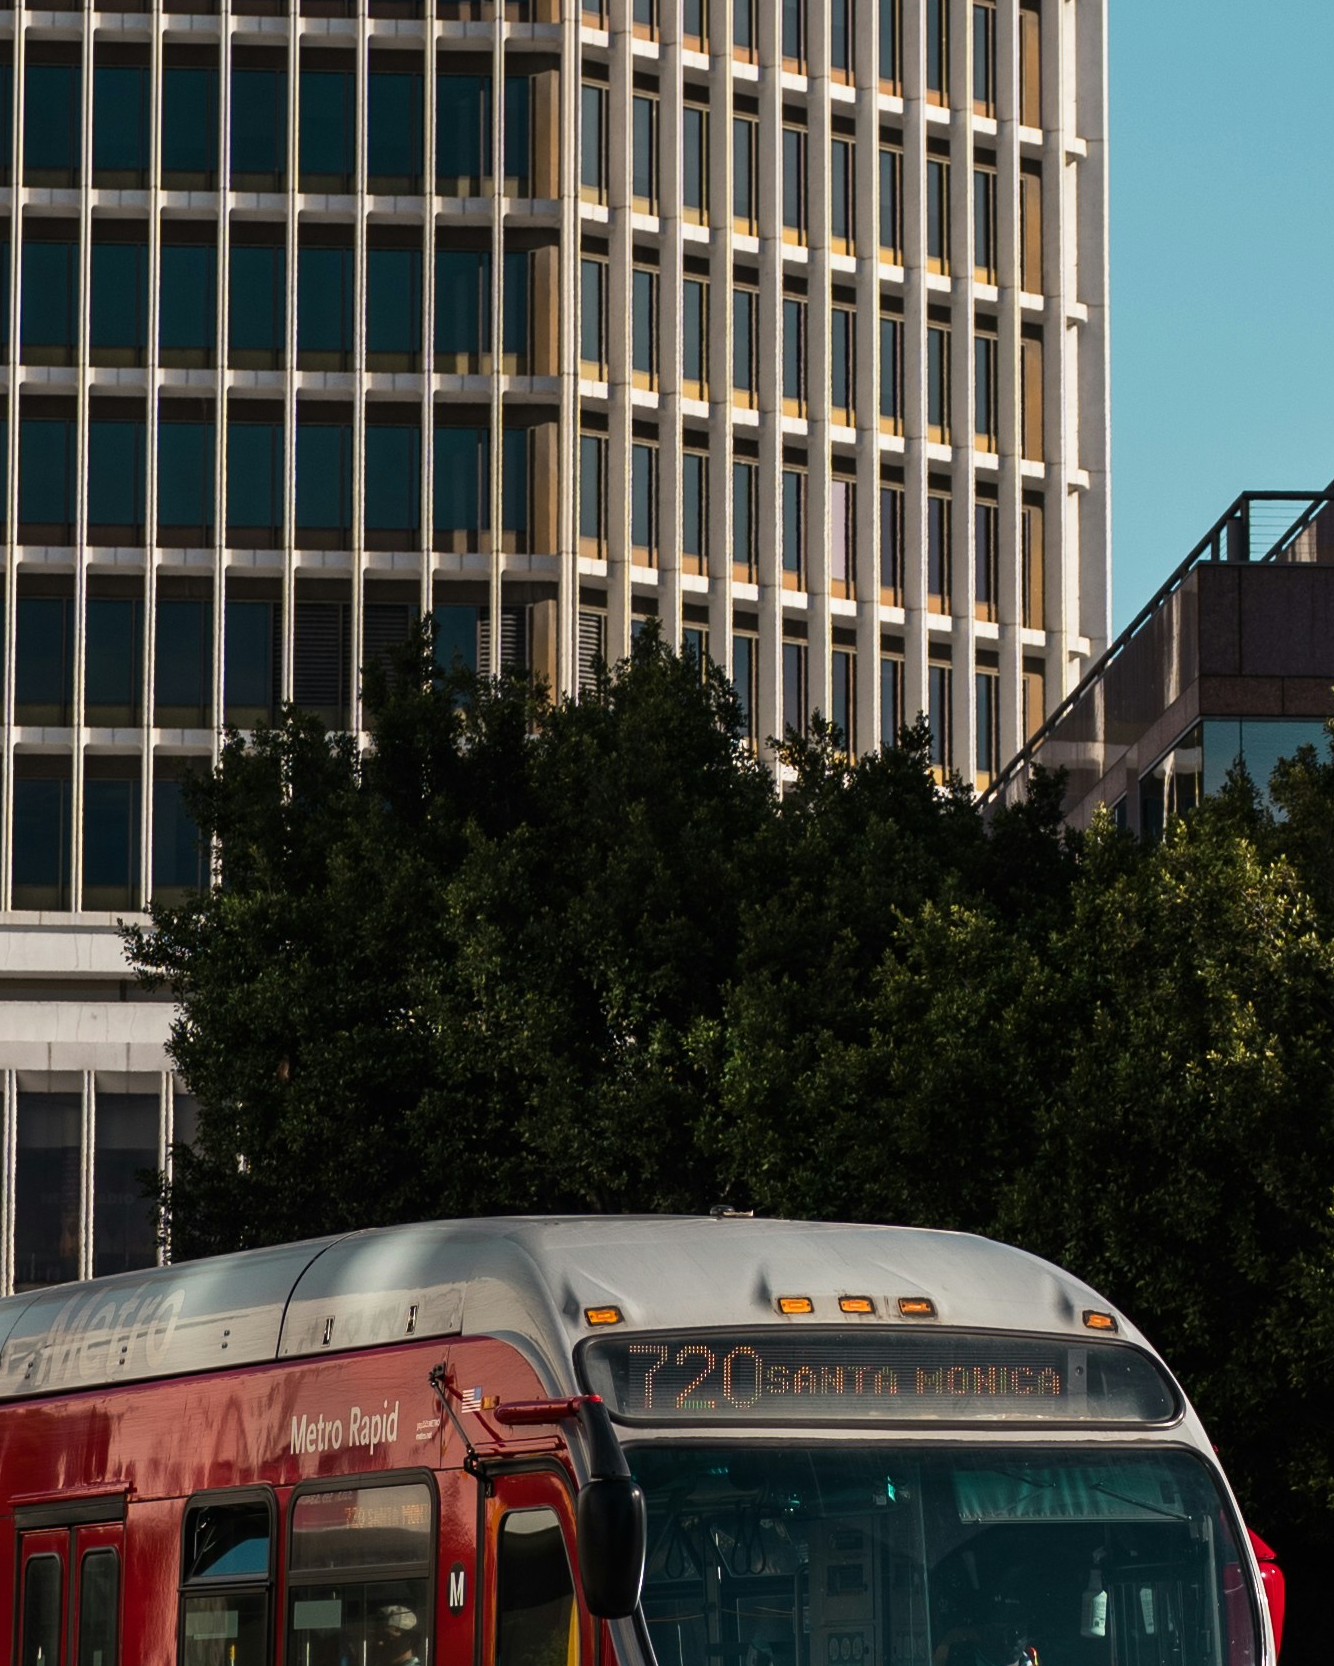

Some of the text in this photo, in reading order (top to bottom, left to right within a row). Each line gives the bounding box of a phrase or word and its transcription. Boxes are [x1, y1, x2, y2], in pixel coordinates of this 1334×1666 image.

[34, 1282, 186, 1386] Metro
[628, 1343, 1061, 1410] 720 SANTA MONICA
[291, 1399, 399, 1456] Metro Rapid
[449, 1572, 464, 1607] M
